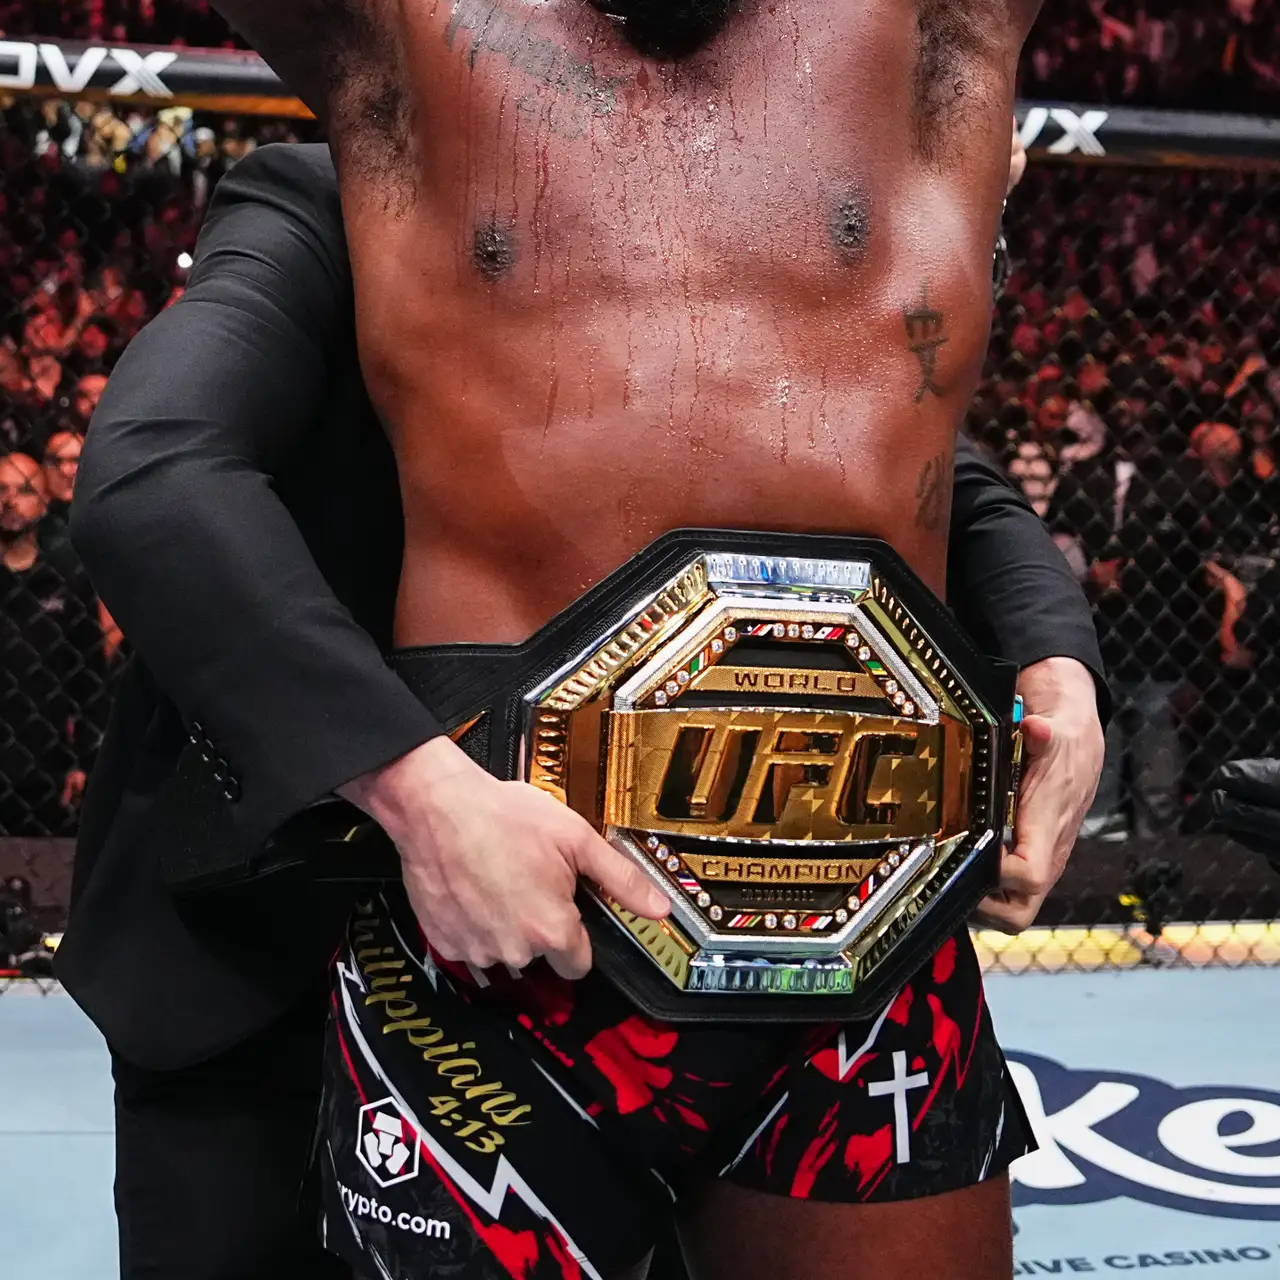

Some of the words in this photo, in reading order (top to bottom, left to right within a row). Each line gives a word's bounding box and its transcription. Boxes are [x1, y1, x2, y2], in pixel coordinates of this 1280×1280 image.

[1017, 106, 1110, 157] VX
[733, 668, 857, 695] WORLD
[654, 723, 919, 827] UFC
[702, 857, 865, 883] CHAMPION
[428, 1094, 507, 1156] 4:13
[1103, 1245, 1271, 1272] CASINO
